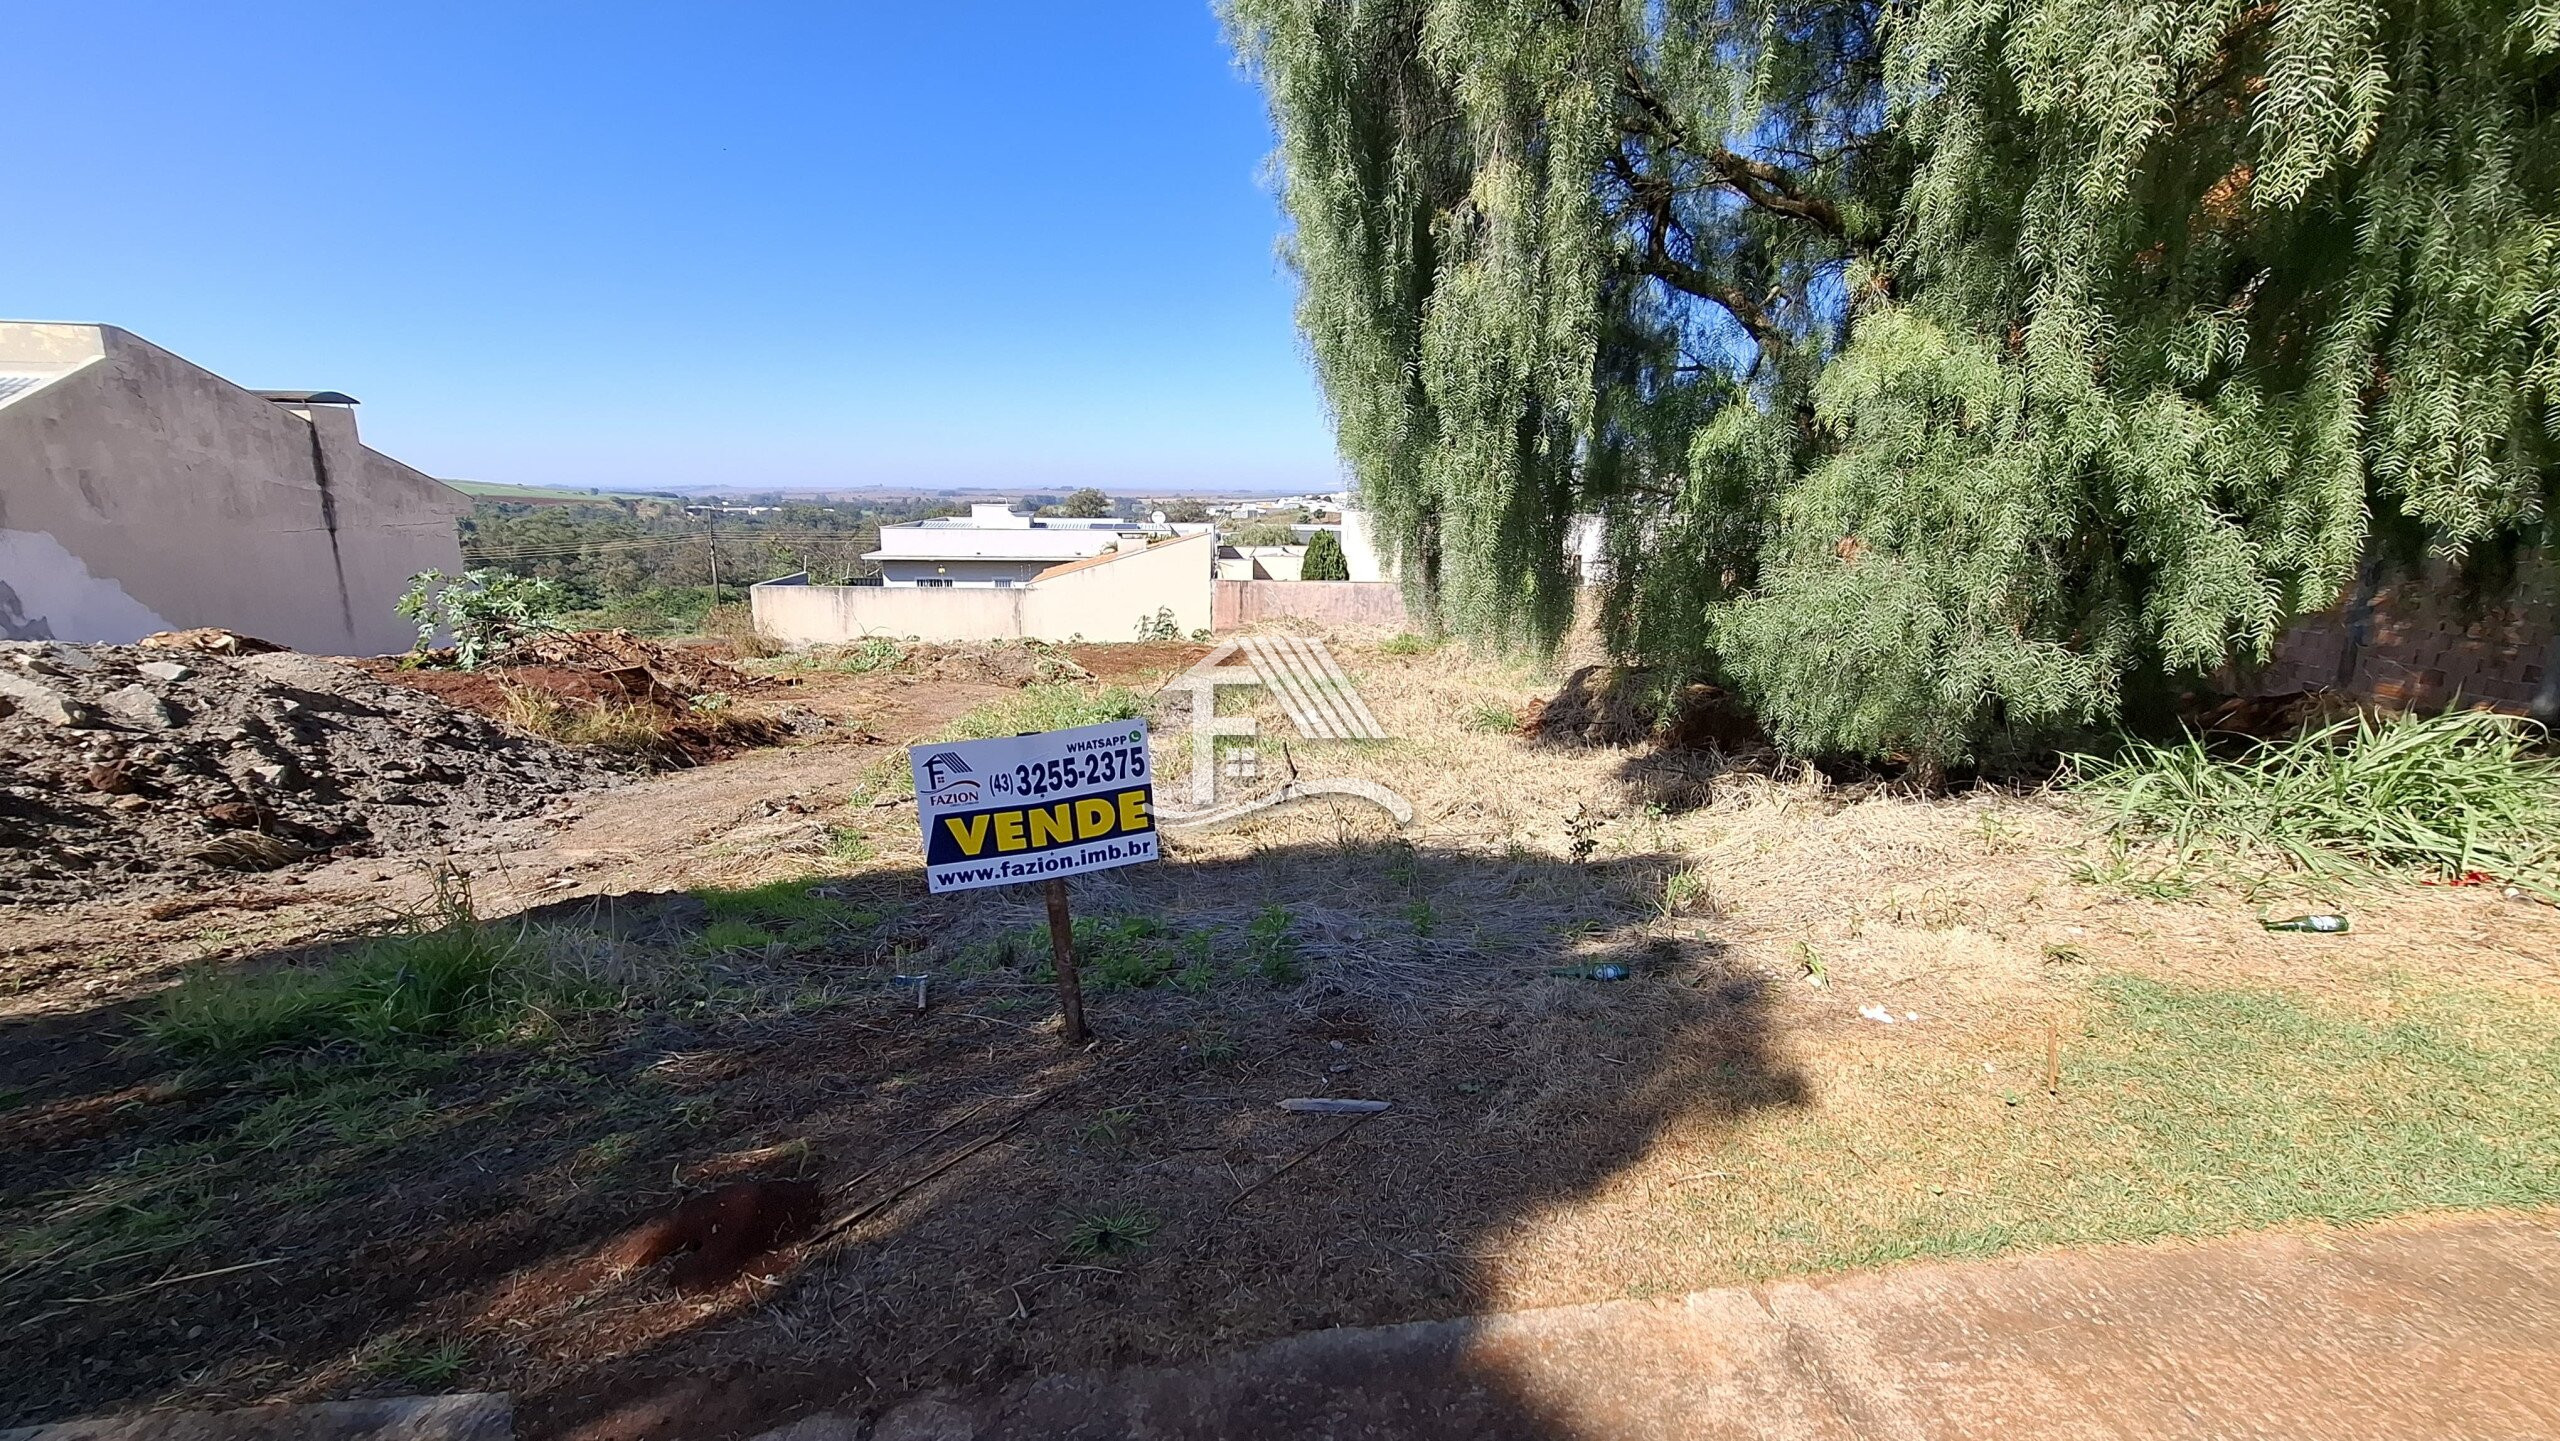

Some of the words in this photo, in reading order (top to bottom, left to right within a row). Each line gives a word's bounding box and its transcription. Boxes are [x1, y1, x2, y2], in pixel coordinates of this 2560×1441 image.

[1066, 735, 1127, 753] WHATSAPP
[989, 773, 1014, 798] (43)
[1015, 746, 1145, 796] 3255-2375
[930, 791, 979, 806] FAZION
[944, 790, 1149, 856] VENDE
[936, 840, 1151, 886] www.fazion.imb.br
